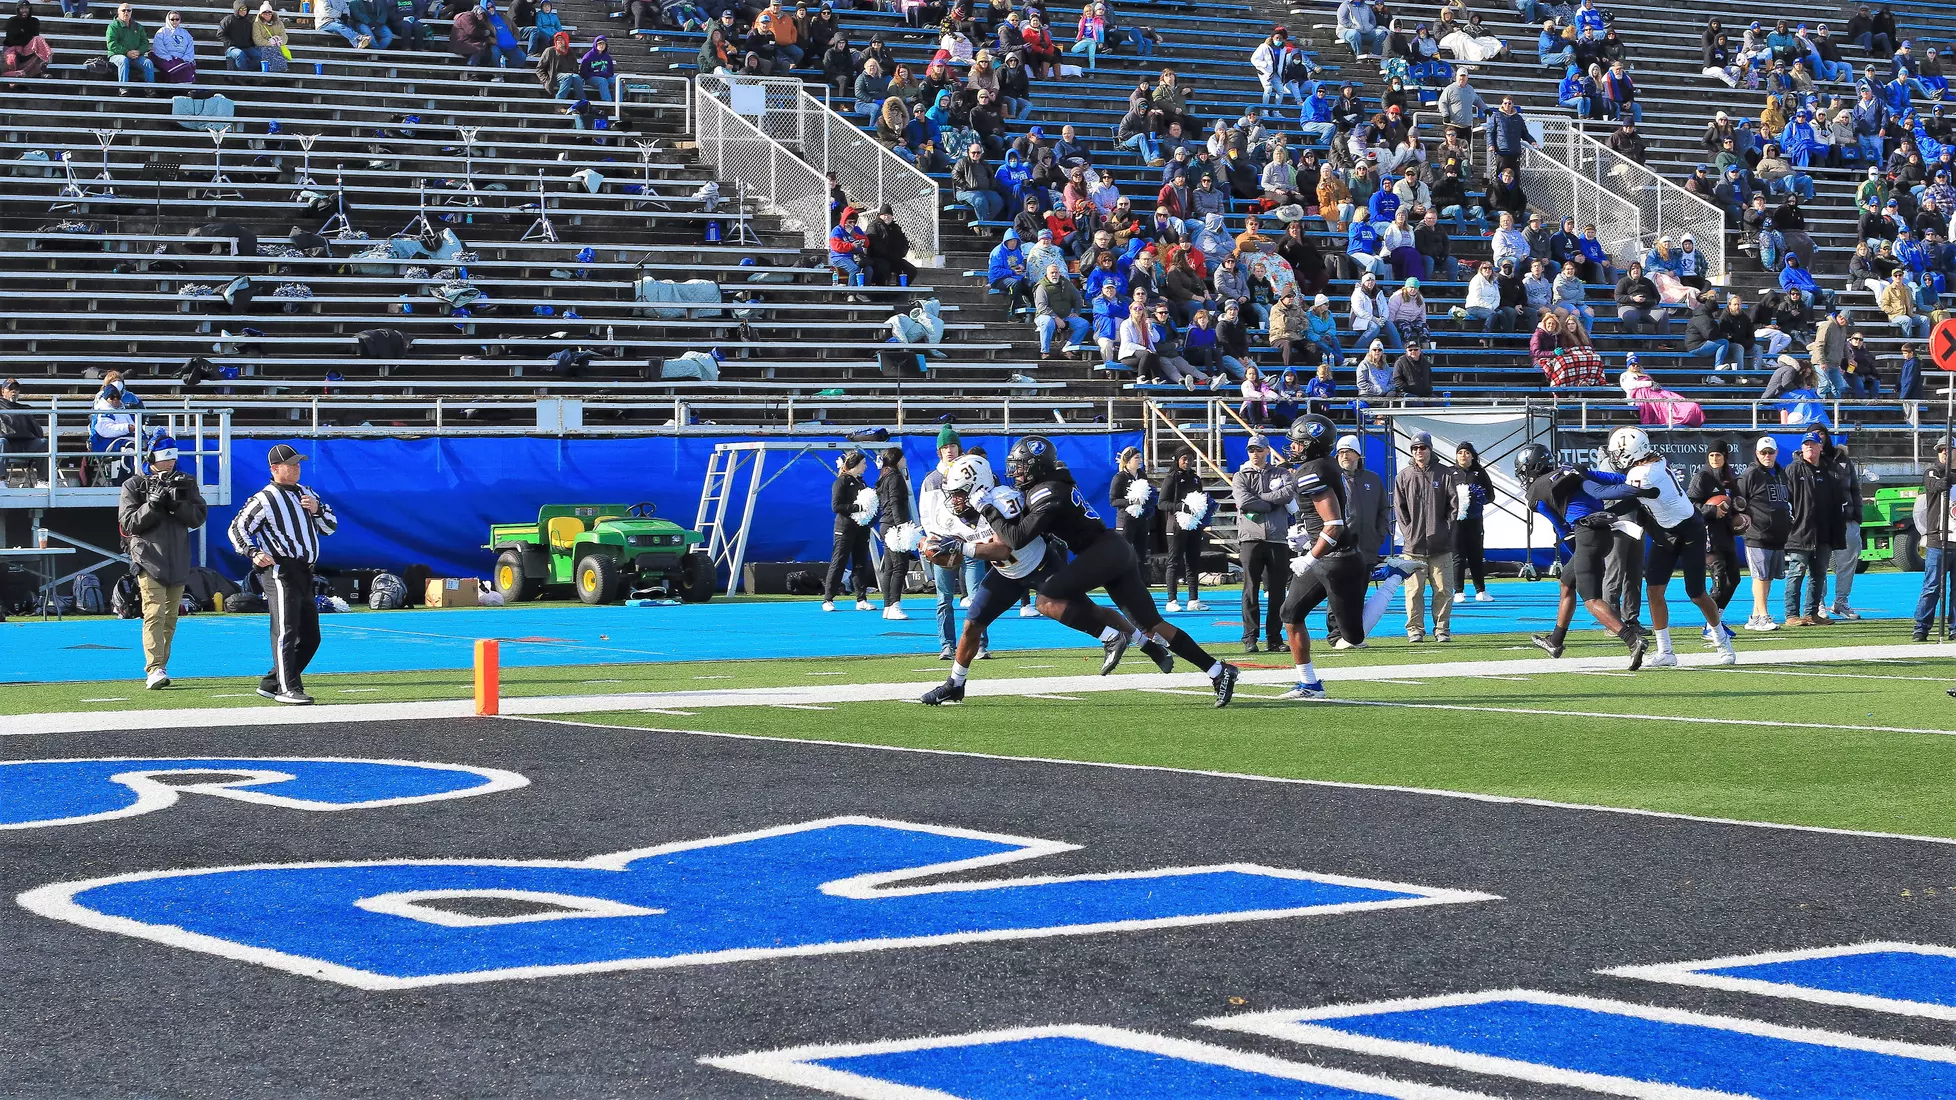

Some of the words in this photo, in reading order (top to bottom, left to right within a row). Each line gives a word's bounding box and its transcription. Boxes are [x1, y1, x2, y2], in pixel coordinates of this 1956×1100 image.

[1660, 443, 1697, 454] SECTION
[1698, 443, 1739, 454] SPOR
[960, 464, 978, 480] 31
[1006, 497, 1022, 514] 31
